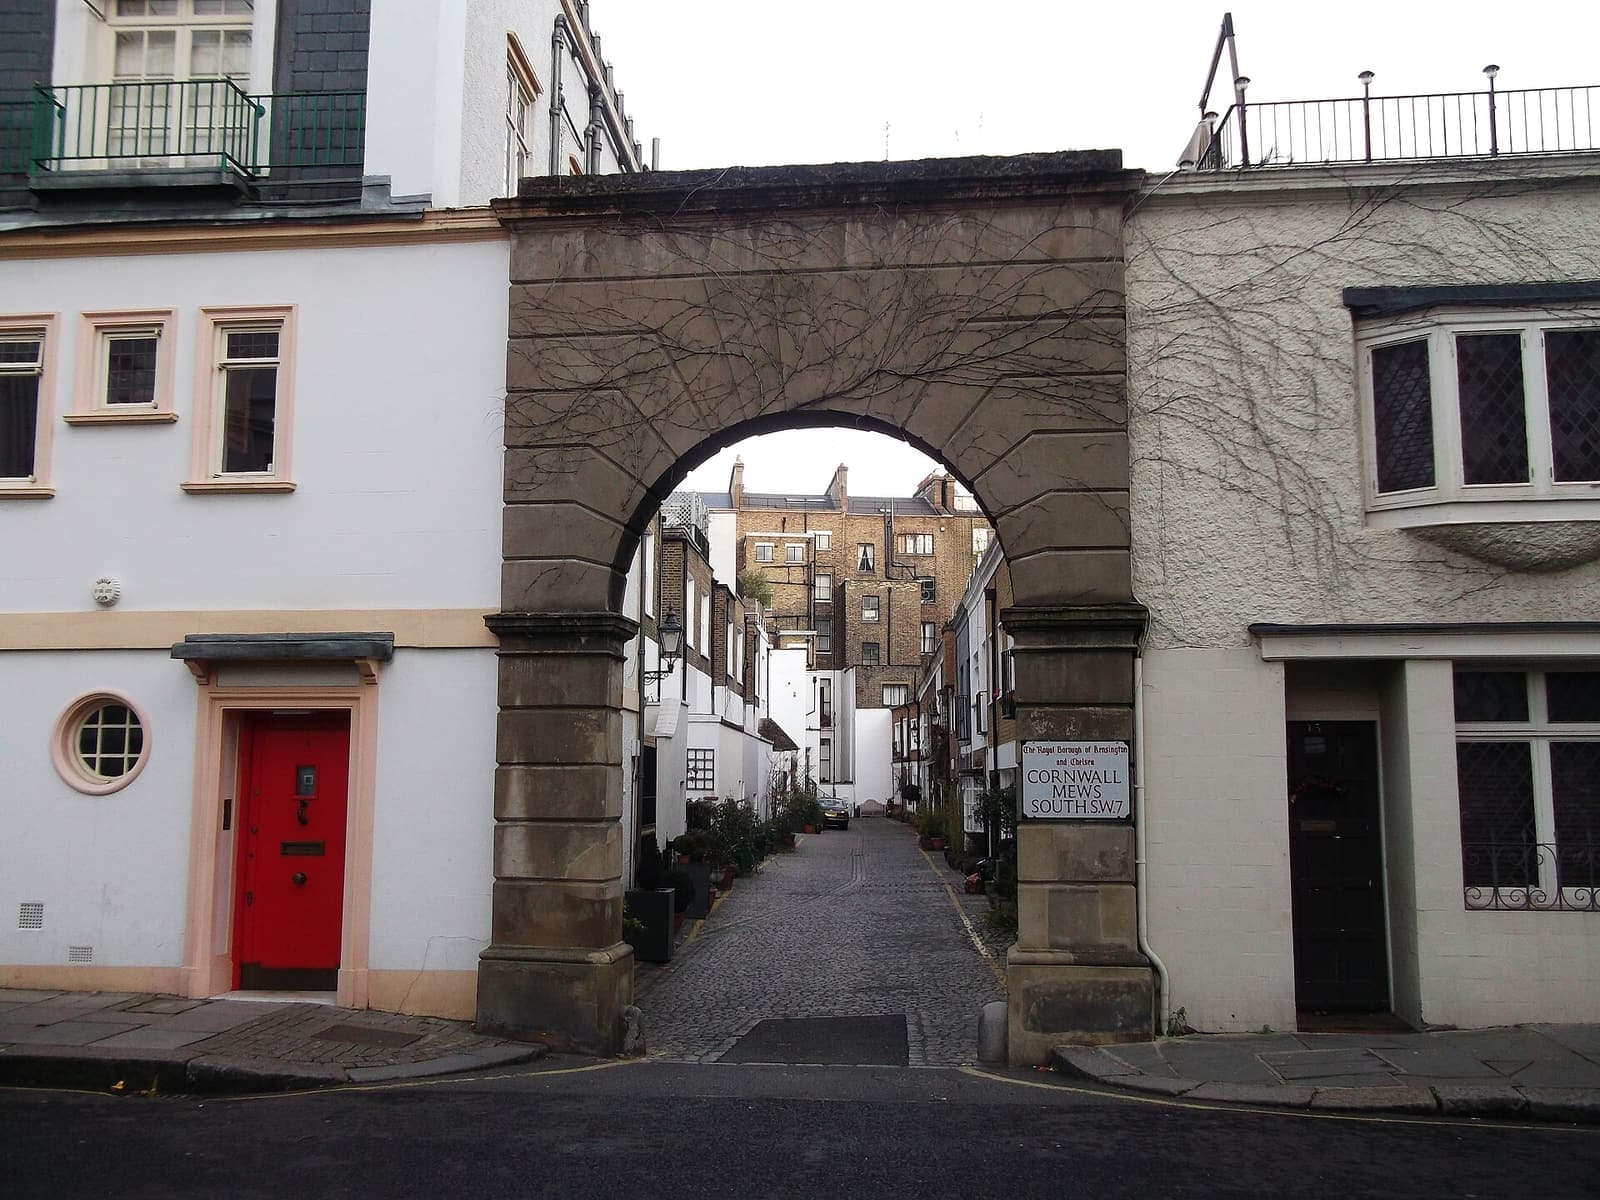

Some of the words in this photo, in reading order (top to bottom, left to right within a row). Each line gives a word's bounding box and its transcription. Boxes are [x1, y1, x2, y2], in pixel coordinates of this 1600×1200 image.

[1023, 746, 1035, 754] The
[1037, 746, 1055, 756] Royal
[1057, 746, 1082, 756] Borough
[1084, 746, 1091, 754] of
[1093, 745, 1128, 756] Kensington
[1056, 758, 1068, 766] and
[1070, 758, 1095, 766] Chelsea
[1027, 769, 1122, 784] CORNWALL
[1052, 784, 1102, 799] MEWS
